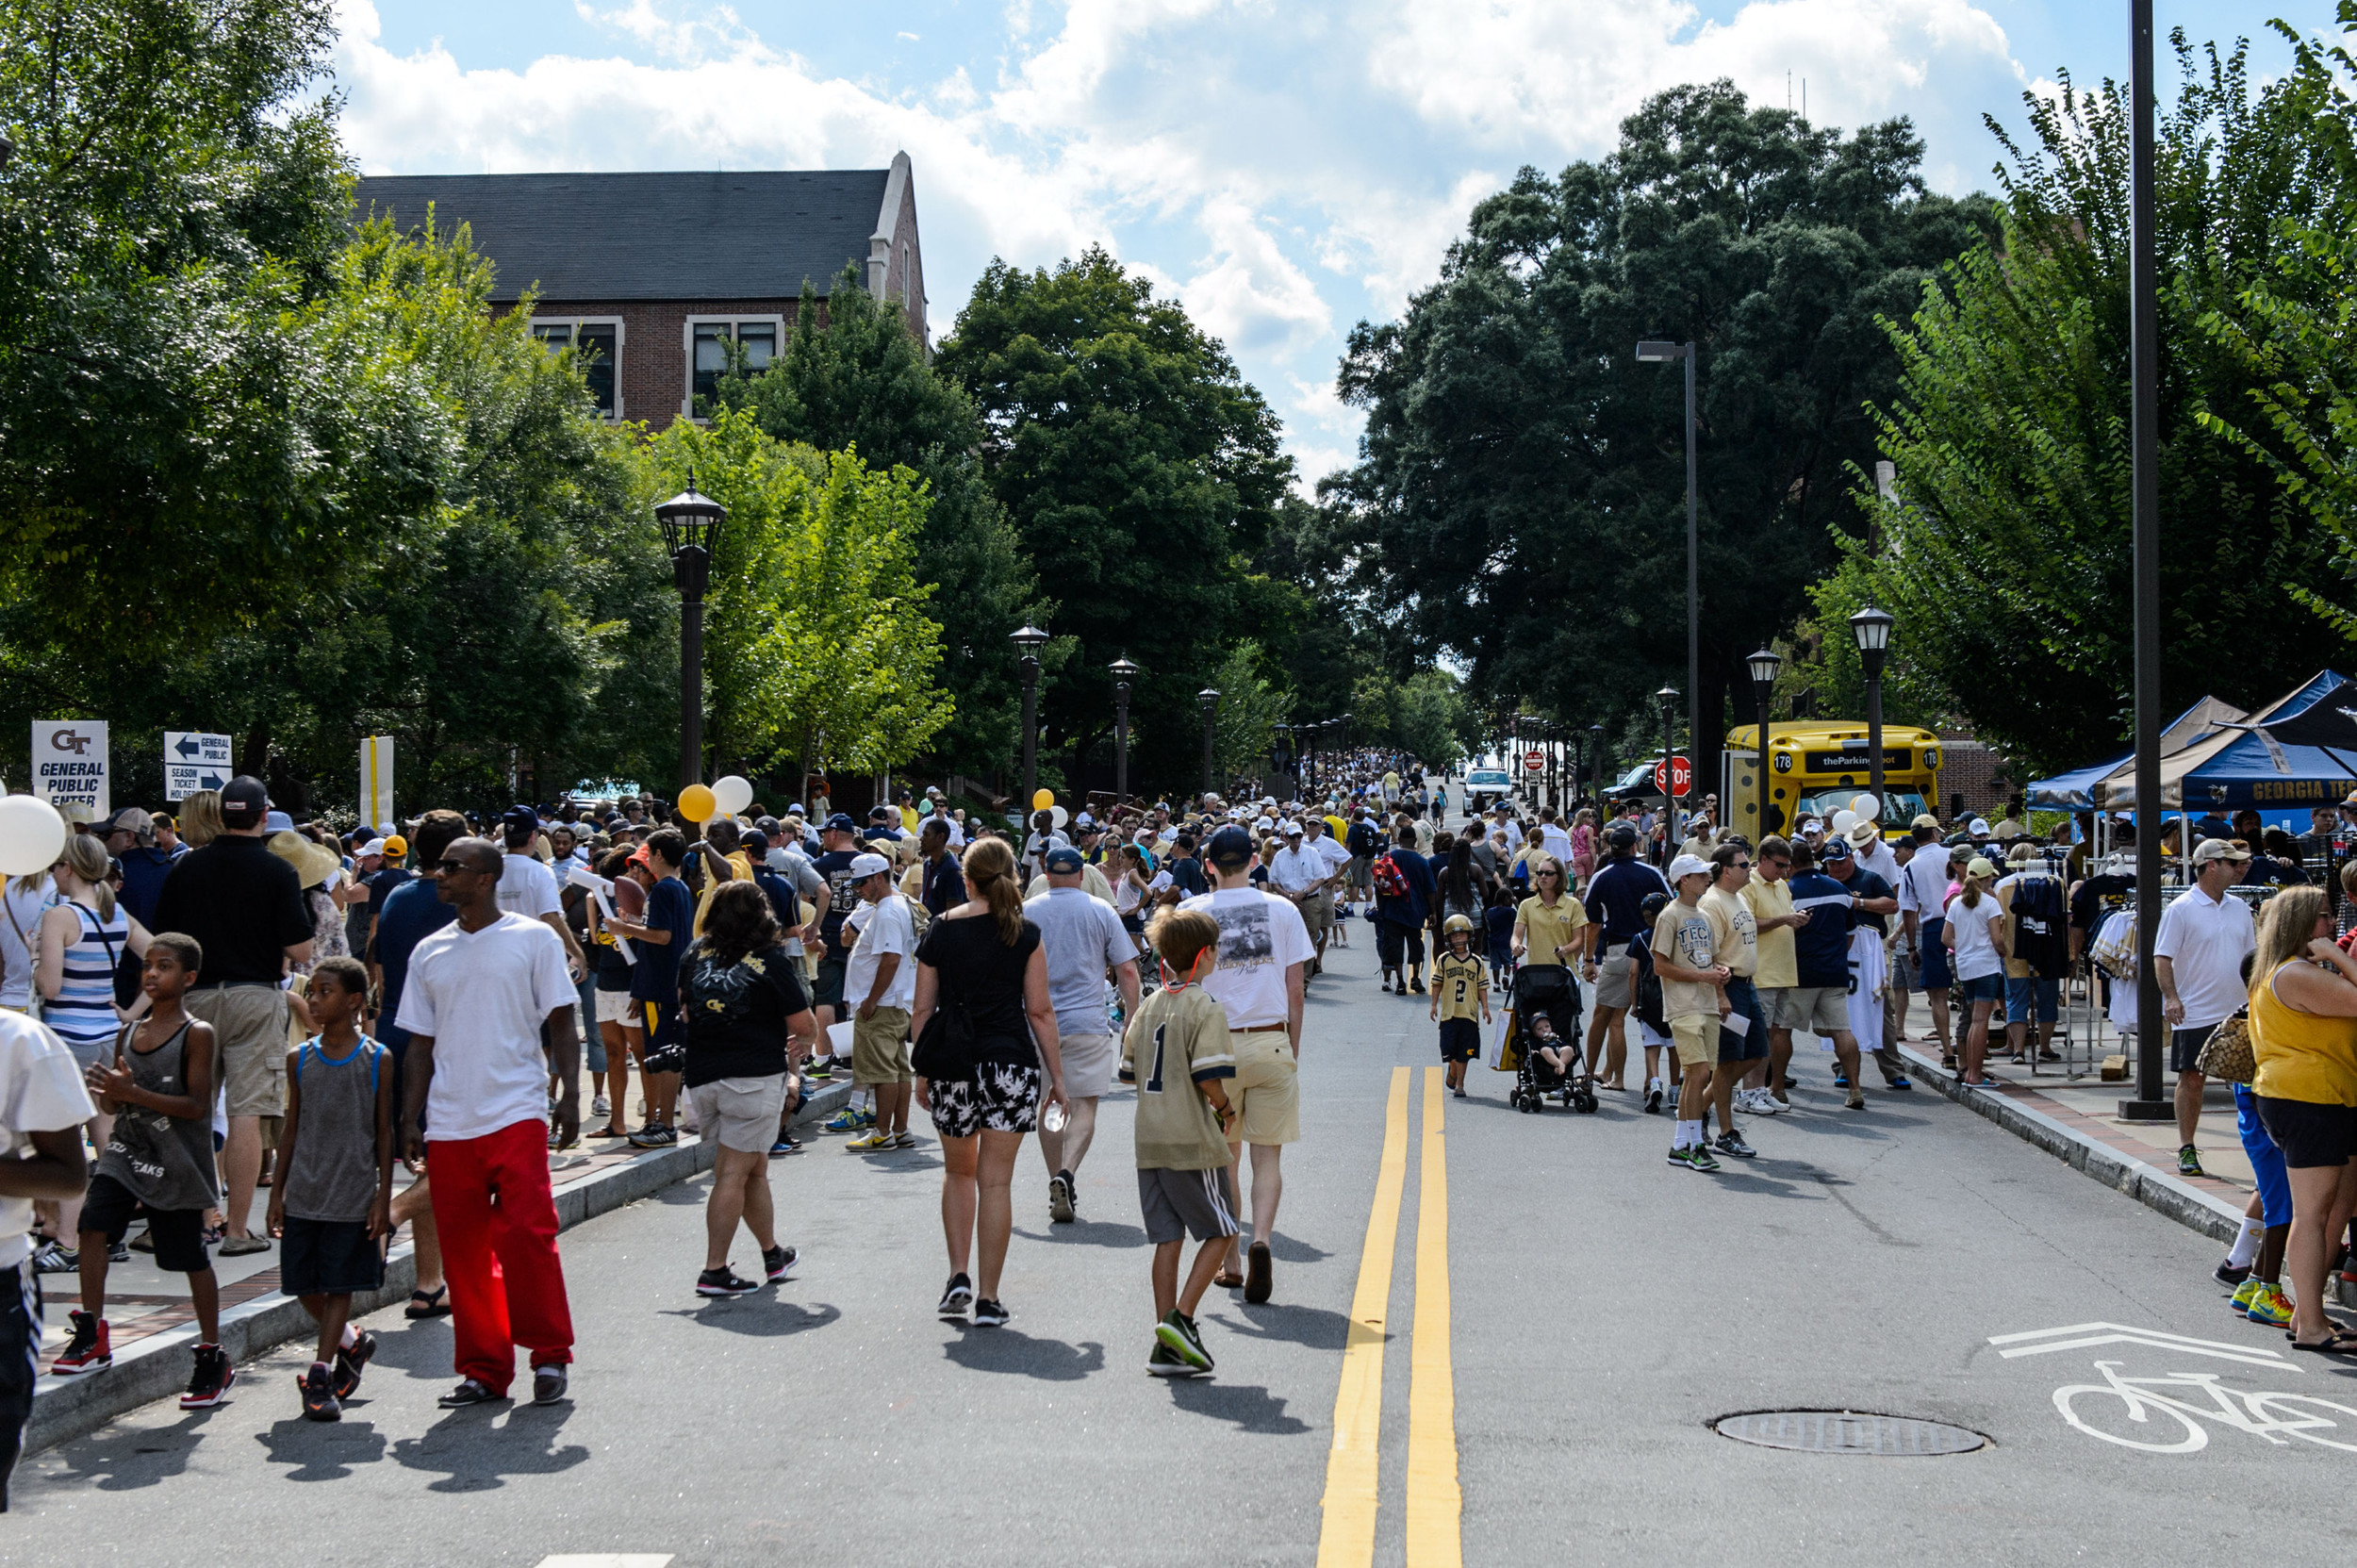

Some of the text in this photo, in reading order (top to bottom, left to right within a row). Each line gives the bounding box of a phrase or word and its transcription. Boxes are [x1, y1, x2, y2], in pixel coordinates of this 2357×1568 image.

[201, 737, 229, 749] GENERAL
[204, 750, 227, 760] PUBLIC
[1773, 755, 1791, 769] 178
[1923, 752, 1937, 766] 178
[40, 762, 105, 777] GENERAL
[172, 767, 198, 779] SEASON
[1658, 768, 1691, 784] SOP
[47, 778, 98, 793] PUBLIC
[173, 779, 196, 789] TICKET
[2252, 781, 2324, 801] GEORGIA
[1455, 979, 1467, 1003] 2
[1144, 1021, 1166, 1094] 1
